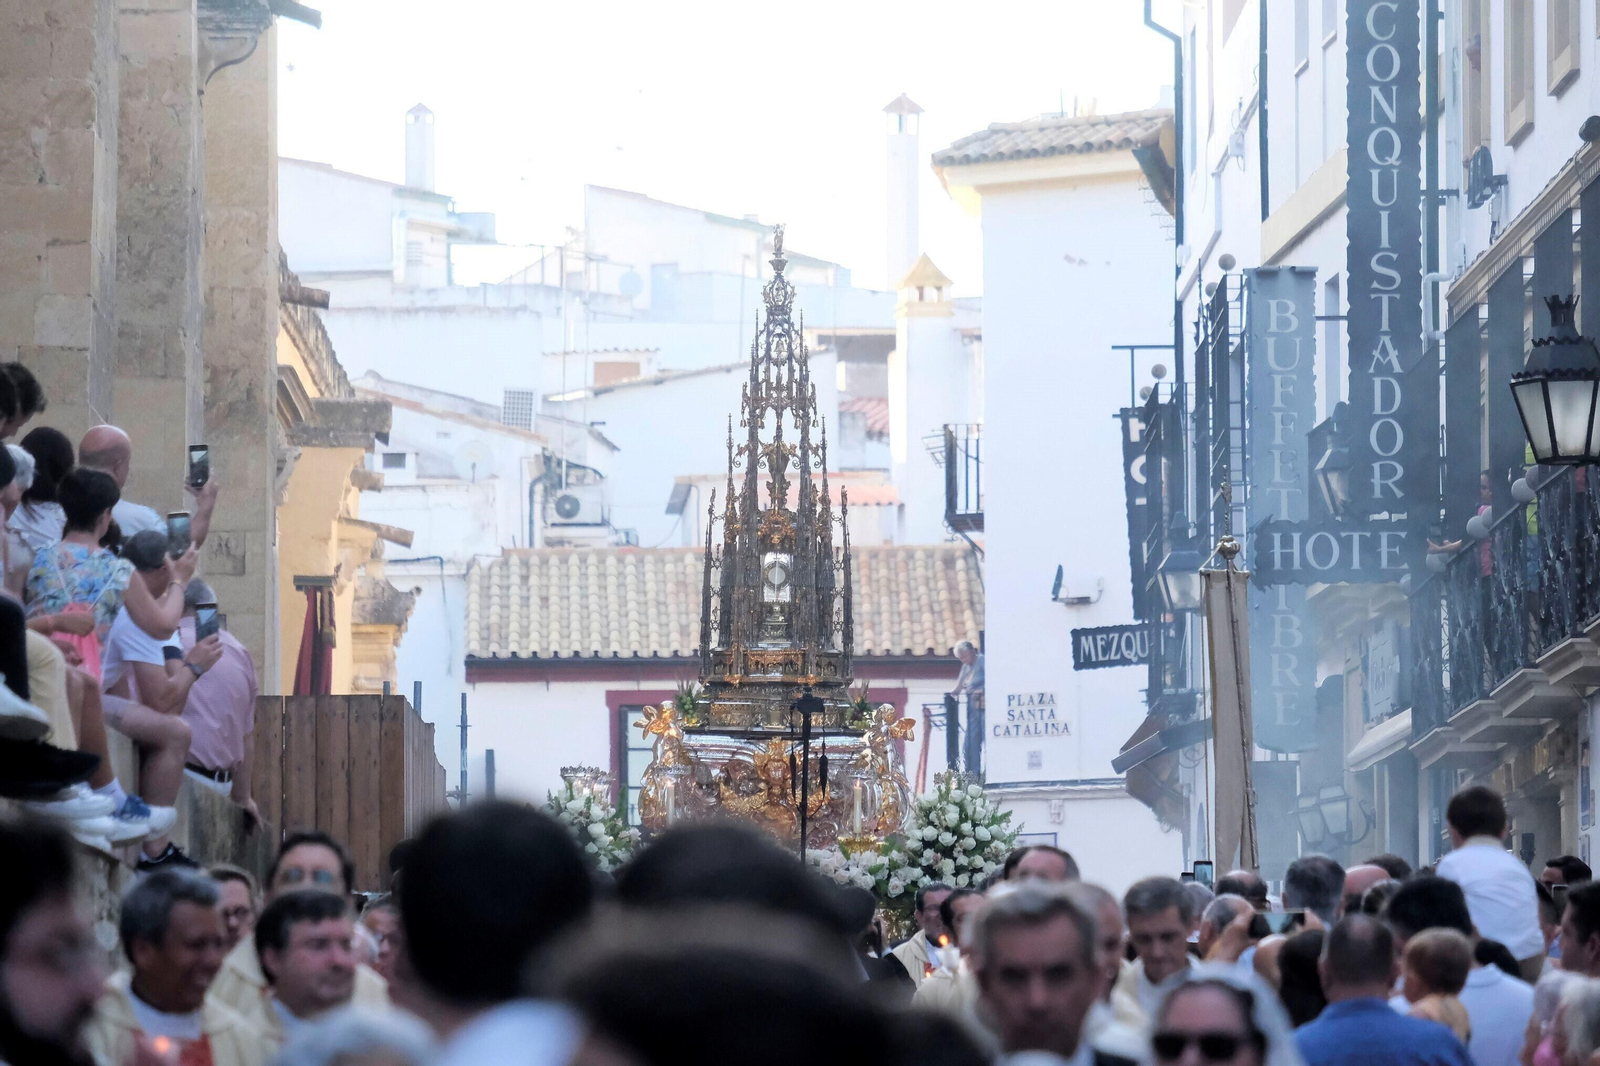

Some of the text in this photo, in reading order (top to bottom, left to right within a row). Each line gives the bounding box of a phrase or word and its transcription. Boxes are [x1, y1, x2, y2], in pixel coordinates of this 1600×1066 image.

[1365, 2, 1405, 499] CONQUISTADOR
[1266, 299, 1302, 522] BUFFET
[1269, 531, 1410, 570] HOTE
[1079, 630, 1149, 663] MEZQU
[1269, 584, 1303, 726] IBRE
[1007, 692, 1056, 707] PLAZA
[1007, 708, 1056, 722] SANTA
[993, 722, 1070, 737] CATALINA
